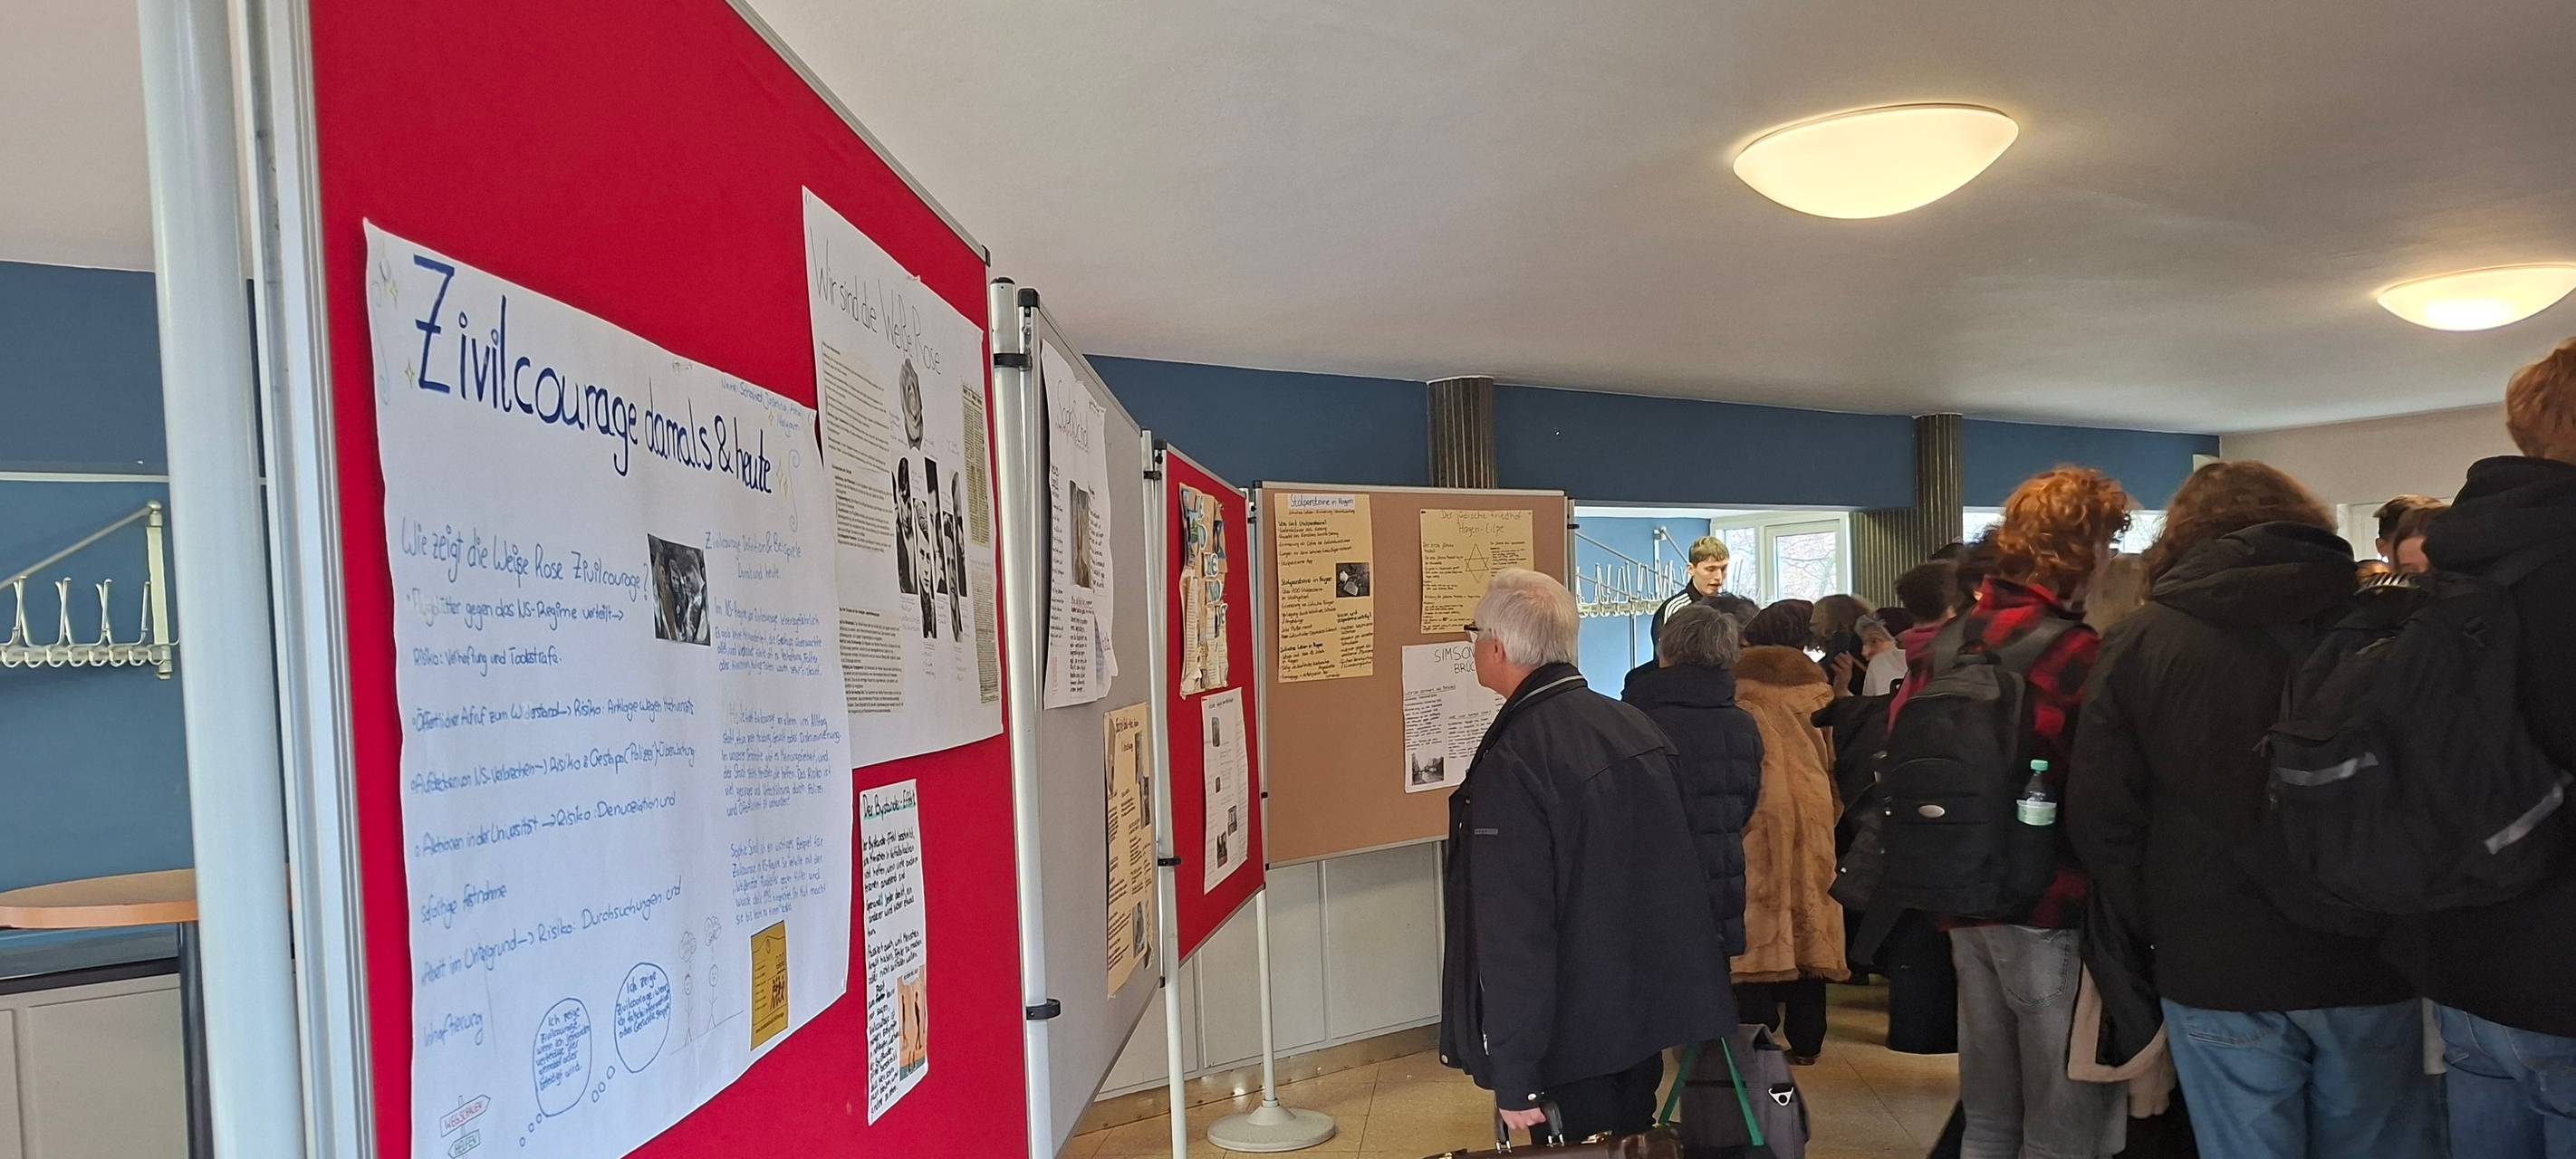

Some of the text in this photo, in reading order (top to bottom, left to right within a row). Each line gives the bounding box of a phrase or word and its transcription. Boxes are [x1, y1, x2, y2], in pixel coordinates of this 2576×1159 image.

[809, 226, 836, 305] Wir
[839, 275, 859, 321] sind
[860, 282, 877, 333] die
[911, 305, 941, 376] Rose
[413, 254, 639, 476] Zivilcourage
[644, 378, 712, 471] damals
[714, 415, 734, 474] &
[735, 417, 773, 494] heute
[402, 517, 428, 556] Wie
[432, 524, 464, 583] zeigt
[467, 527, 488, 569] die
[535, 543, 563, 580] Rose
[465, 603, 493, 631] gegen
[495, 598, 516, 618] das
[490, 648, 506, 666] und
[489, 711, 509, 724] zum
[666, 874, 682, 901] und
[626, 971, 656, 994] Ich zeige
